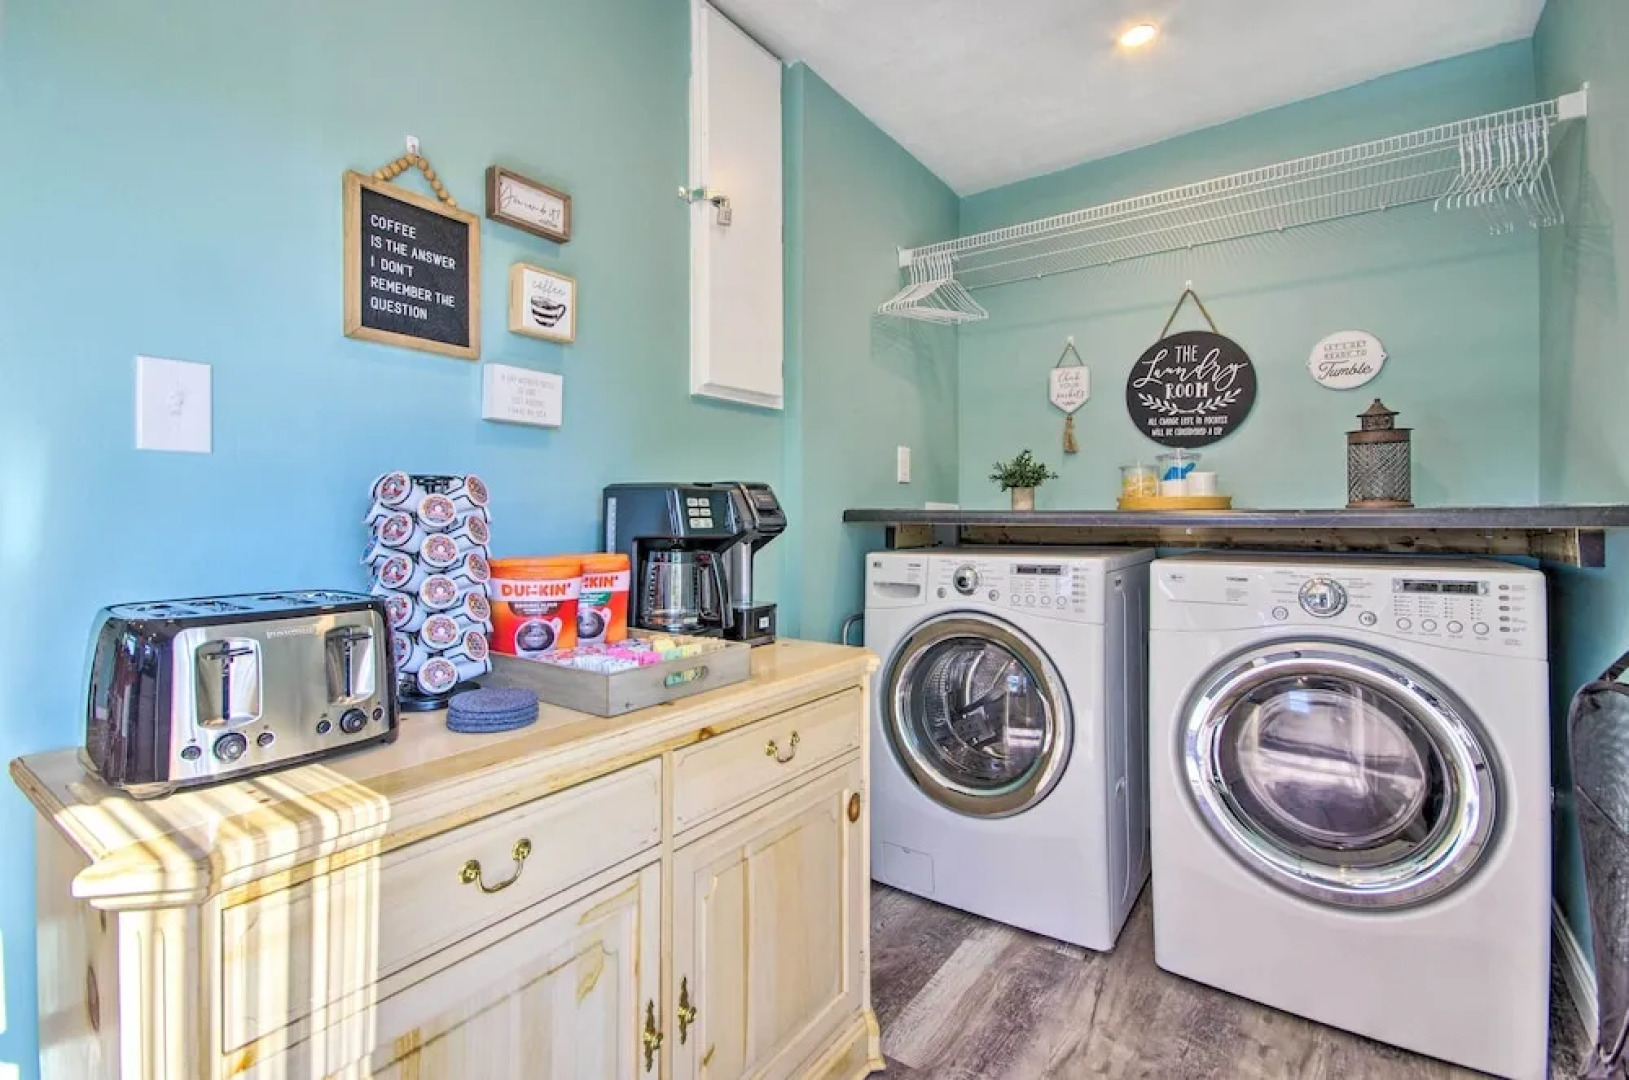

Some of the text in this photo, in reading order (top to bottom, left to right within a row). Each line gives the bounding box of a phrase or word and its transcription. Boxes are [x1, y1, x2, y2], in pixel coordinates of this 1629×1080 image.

[370, 214, 417, 239] COFFEE
[370, 234, 456, 270] IS THE ANSWER
[370, 255, 415, 278] I DON'T
[370, 275, 456, 308] REMEMBER THE
[370, 296, 428, 320] QUESTION
[1174, 344, 1200, 363] THE
[1133, 348, 1249, 392] Laundry
[1318, 360, 1374, 381] Tumble
[1165, 382, 1209, 400] ROOM
